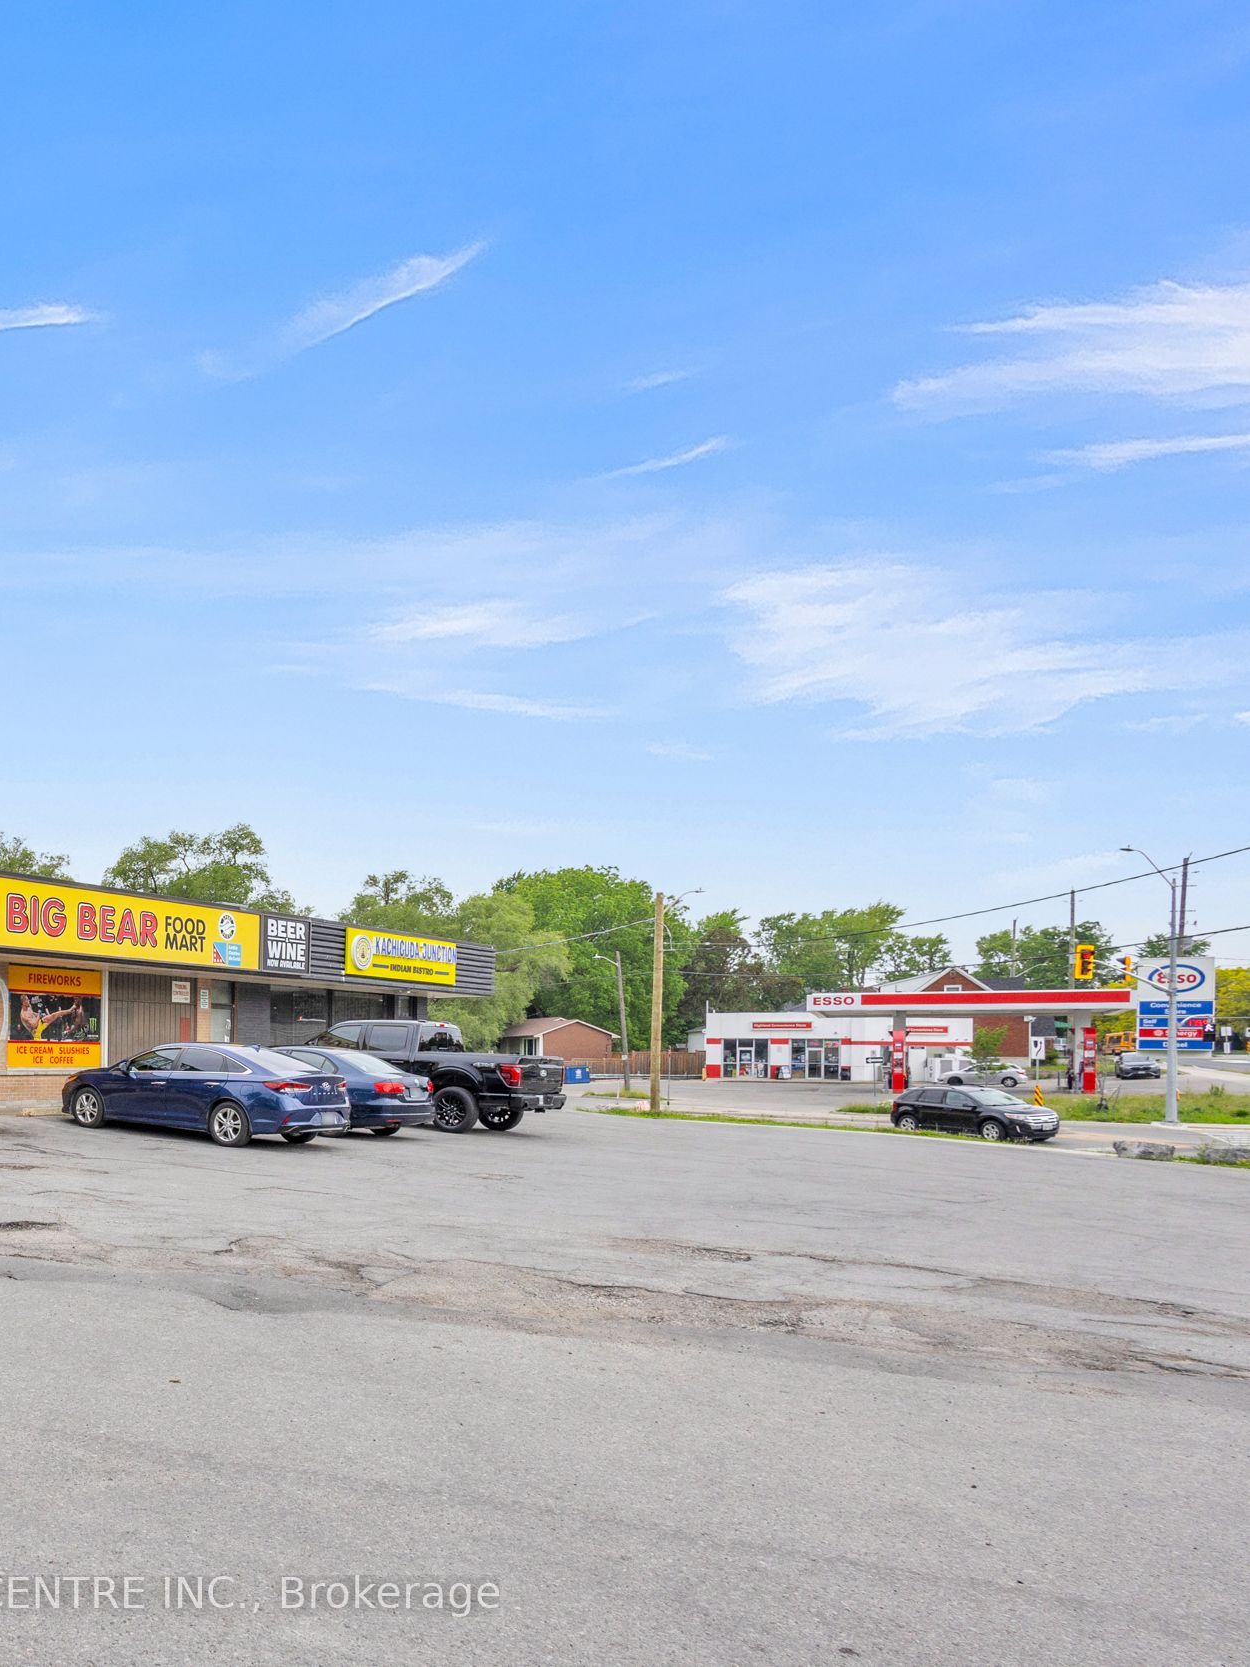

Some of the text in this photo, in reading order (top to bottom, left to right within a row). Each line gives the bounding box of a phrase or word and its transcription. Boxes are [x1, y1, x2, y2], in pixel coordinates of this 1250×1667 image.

[6, 893, 158, 948] BIG BEAR
[164, 915, 206, 936] FOOD
[267, 918, 306, 940] BEER
[164, 932, 206, 953] MART
[267, 940, 306, 961] WINE
[422, 943, 457, 964] JUNCTION
[266, 958, 306, 970] NOW AVAILABLE
[390, 963, 434, 976] INDIAN BISTRO
[28, 973, 82, 987] FIREWORKS
[813, 996, 855, 1006] ESSO
[16, 1046, 90, 1055] ICE CREAM SLUSHIES
[32, 1056, 74, 1064] ICE COFFEE
